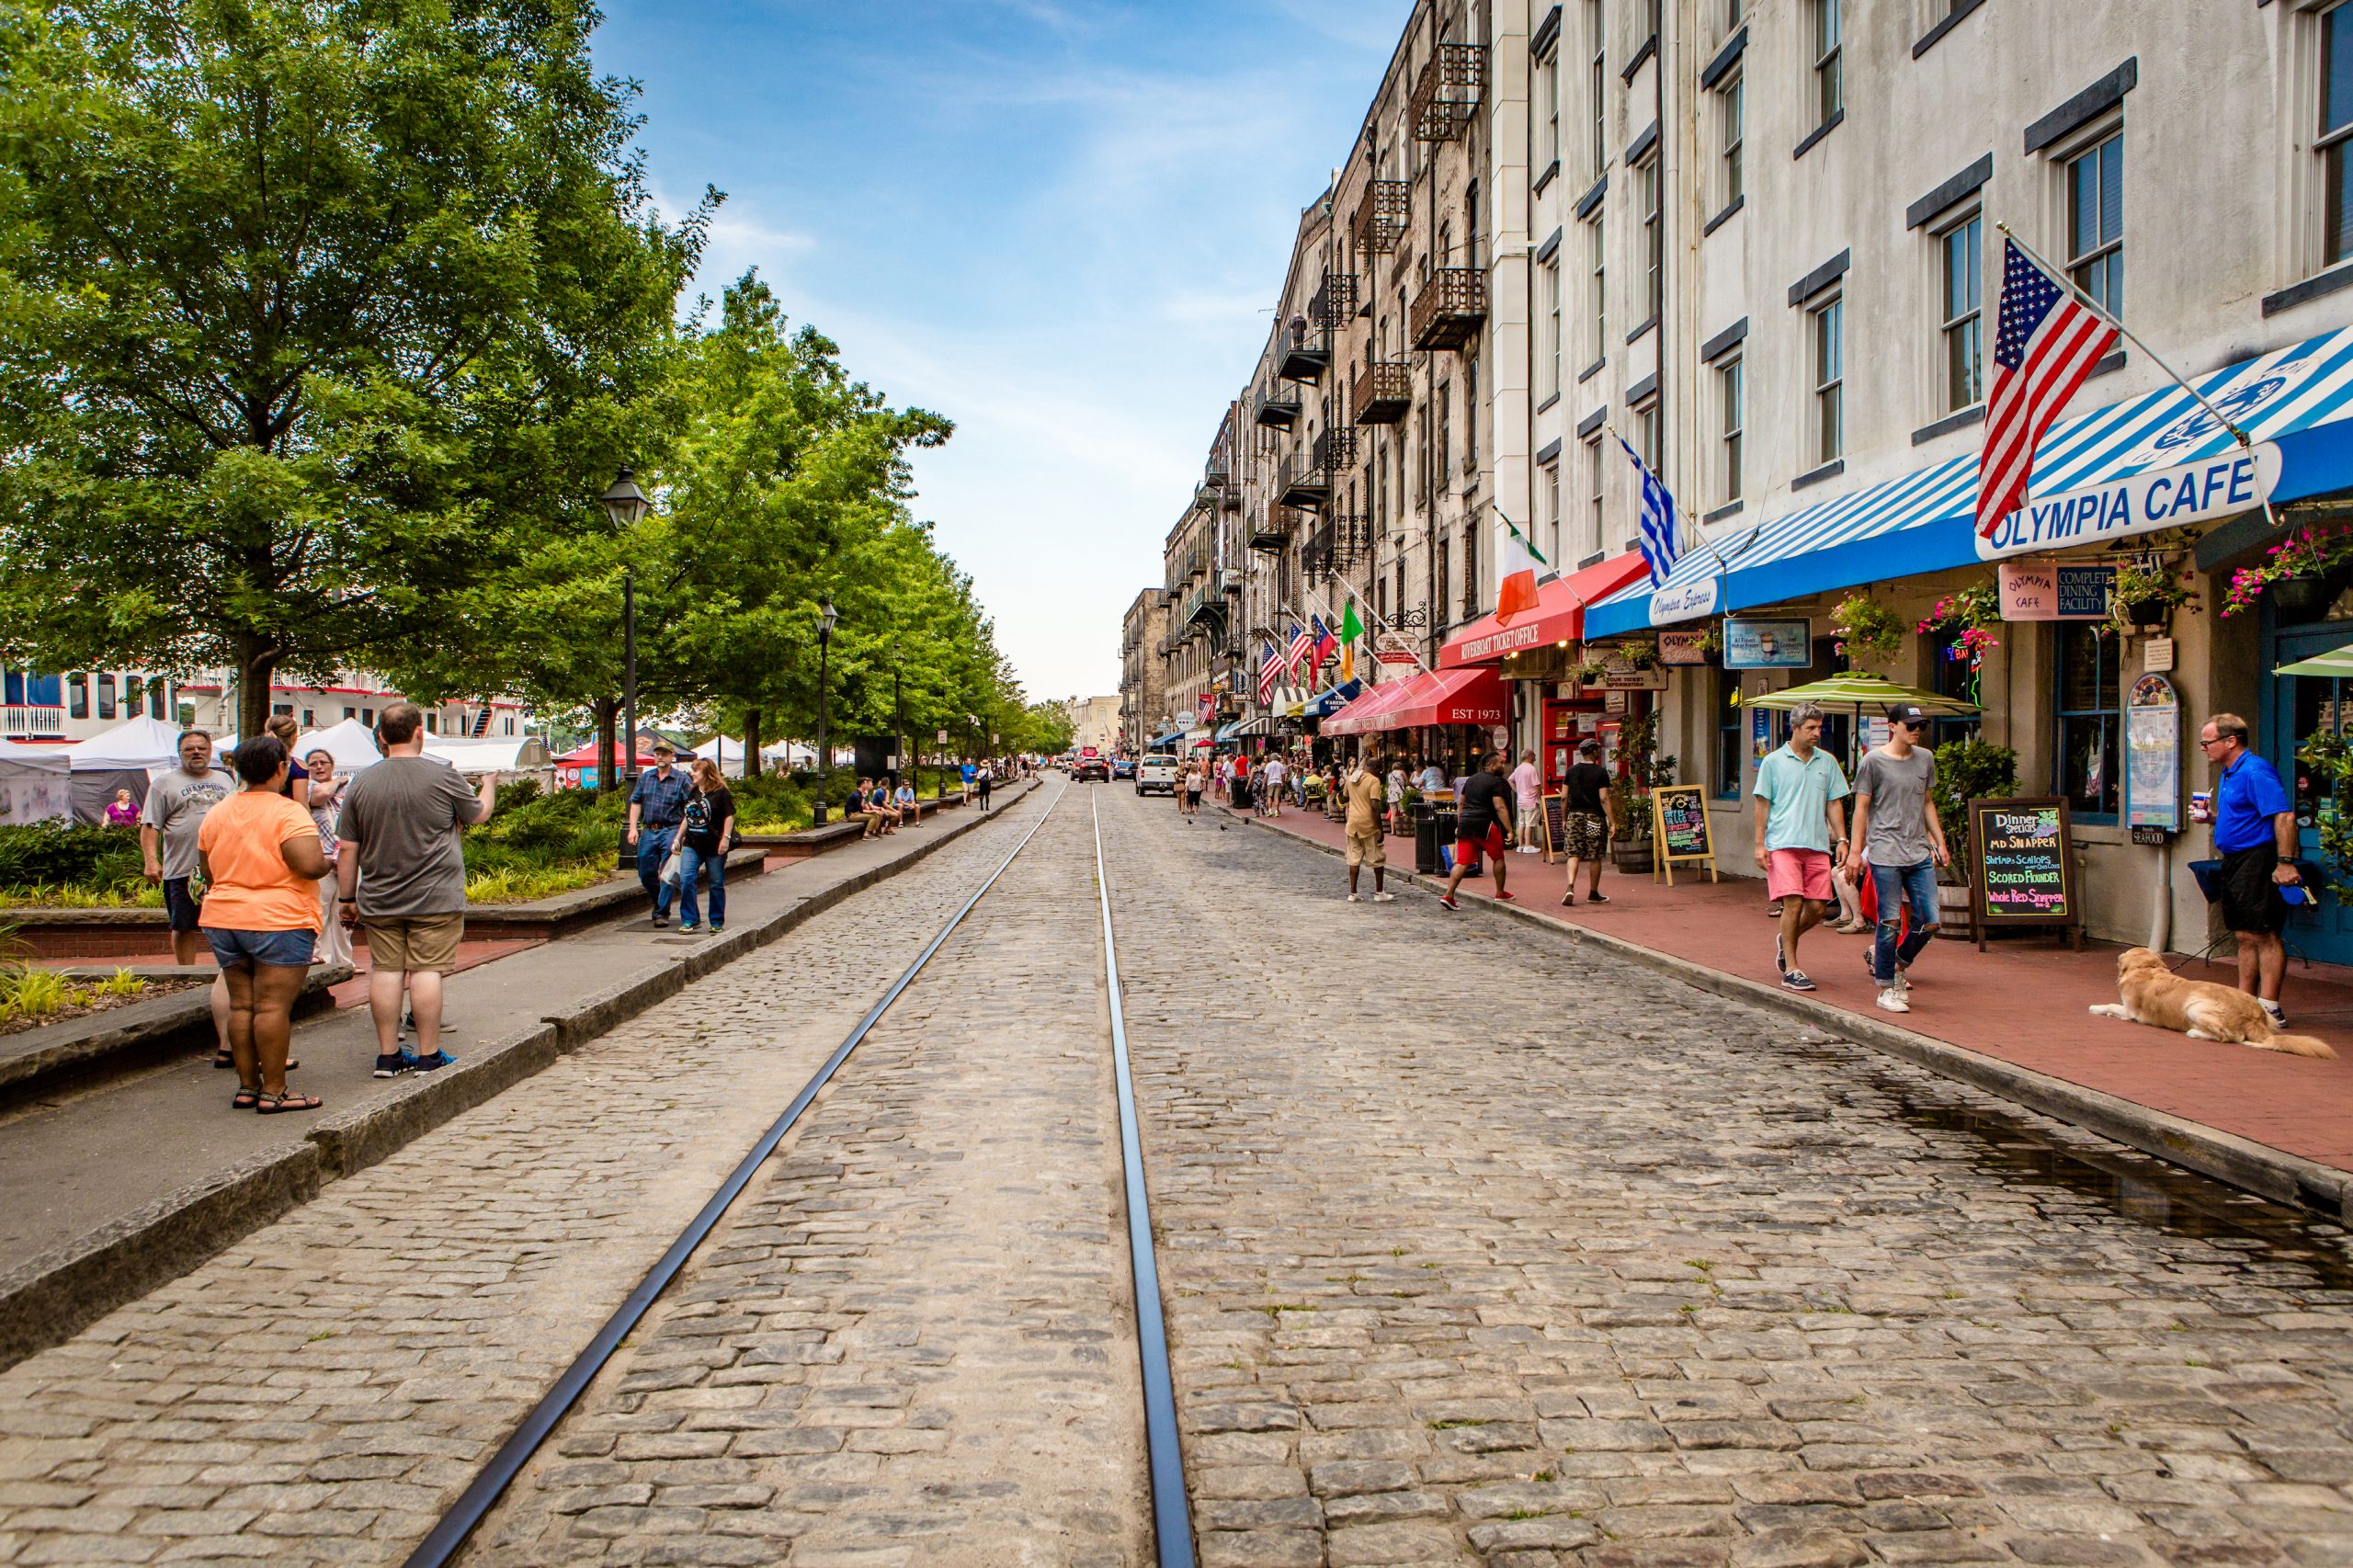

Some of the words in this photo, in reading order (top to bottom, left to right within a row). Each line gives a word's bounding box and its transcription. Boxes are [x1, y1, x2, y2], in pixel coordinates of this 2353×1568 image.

[1991, 487, 2131, 550] OLYMPIA
[2145, 455, 2258, 522] CAFE
[2009, 574, 2051, 592] OLYMPIA
[2059, 572, 2111, 585] COMPLETE
[2059, 585, 2097, 597] DINING
[1654, 597, 1680, 618] Olympia
[1684, 588, 1711, 611] Express
[2059, 597, 2103, 610] FACILITY
[1461, 636, 1493, 661] RIVERBOAT
[1493, 630, 1515, 653] TICKET
[1515, 624, 1539, 647] OFFICE
[1955, 648, 1969, 660] BA
[1452, 709, 1474, 720] EST
[1478, 709, 1501, 720] 1973
[1995, 813, 2040, 828] Dinner
[2133, 831, 2164, 844] SEAFOOD
[1987, 891, 2010, 903] Whole
